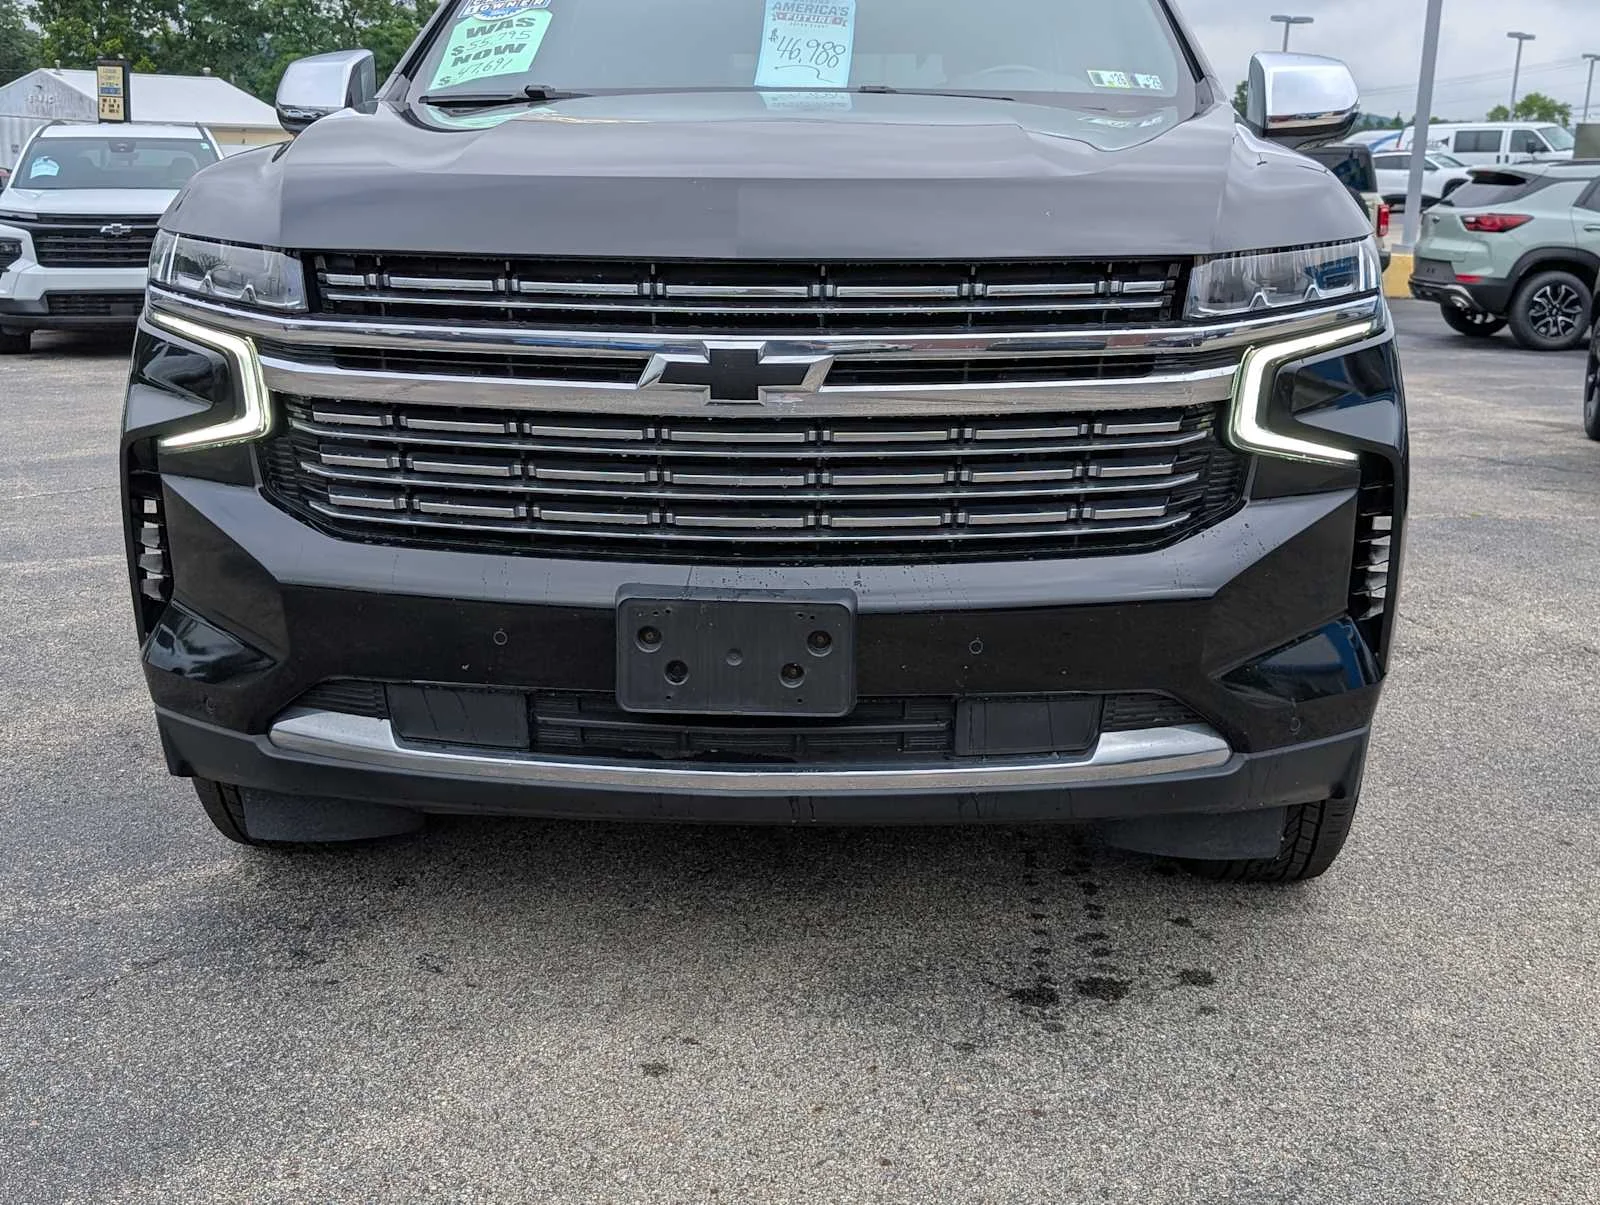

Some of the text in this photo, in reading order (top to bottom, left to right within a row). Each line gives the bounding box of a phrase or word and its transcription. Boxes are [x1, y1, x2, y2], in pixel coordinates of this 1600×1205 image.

[772, 2, 849, 16] AMERICA'S
[466, 17, 536, 39] WAS
[451, 43, 528, 67] NOW
